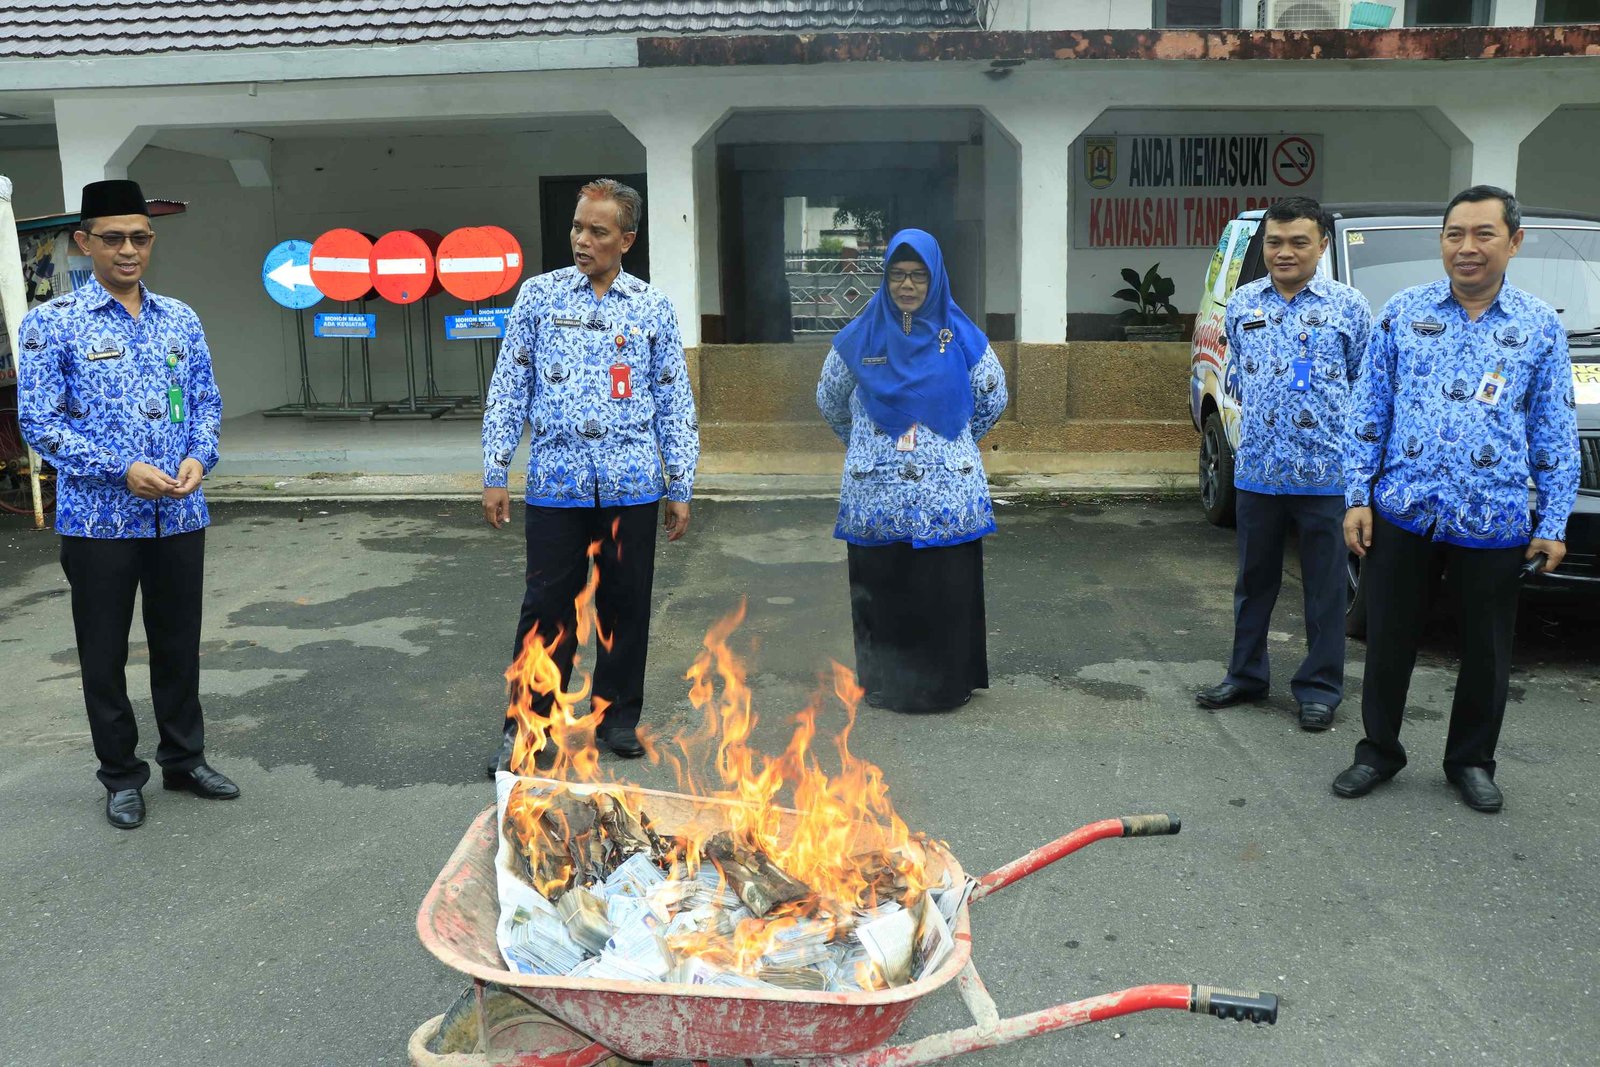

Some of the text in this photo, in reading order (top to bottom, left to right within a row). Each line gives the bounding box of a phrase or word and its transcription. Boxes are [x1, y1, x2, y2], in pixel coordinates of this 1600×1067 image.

[1129, 135, 1268, 188] ANDA MEMASUKI
[1089, 197, 1178, 247] KAWASAN
